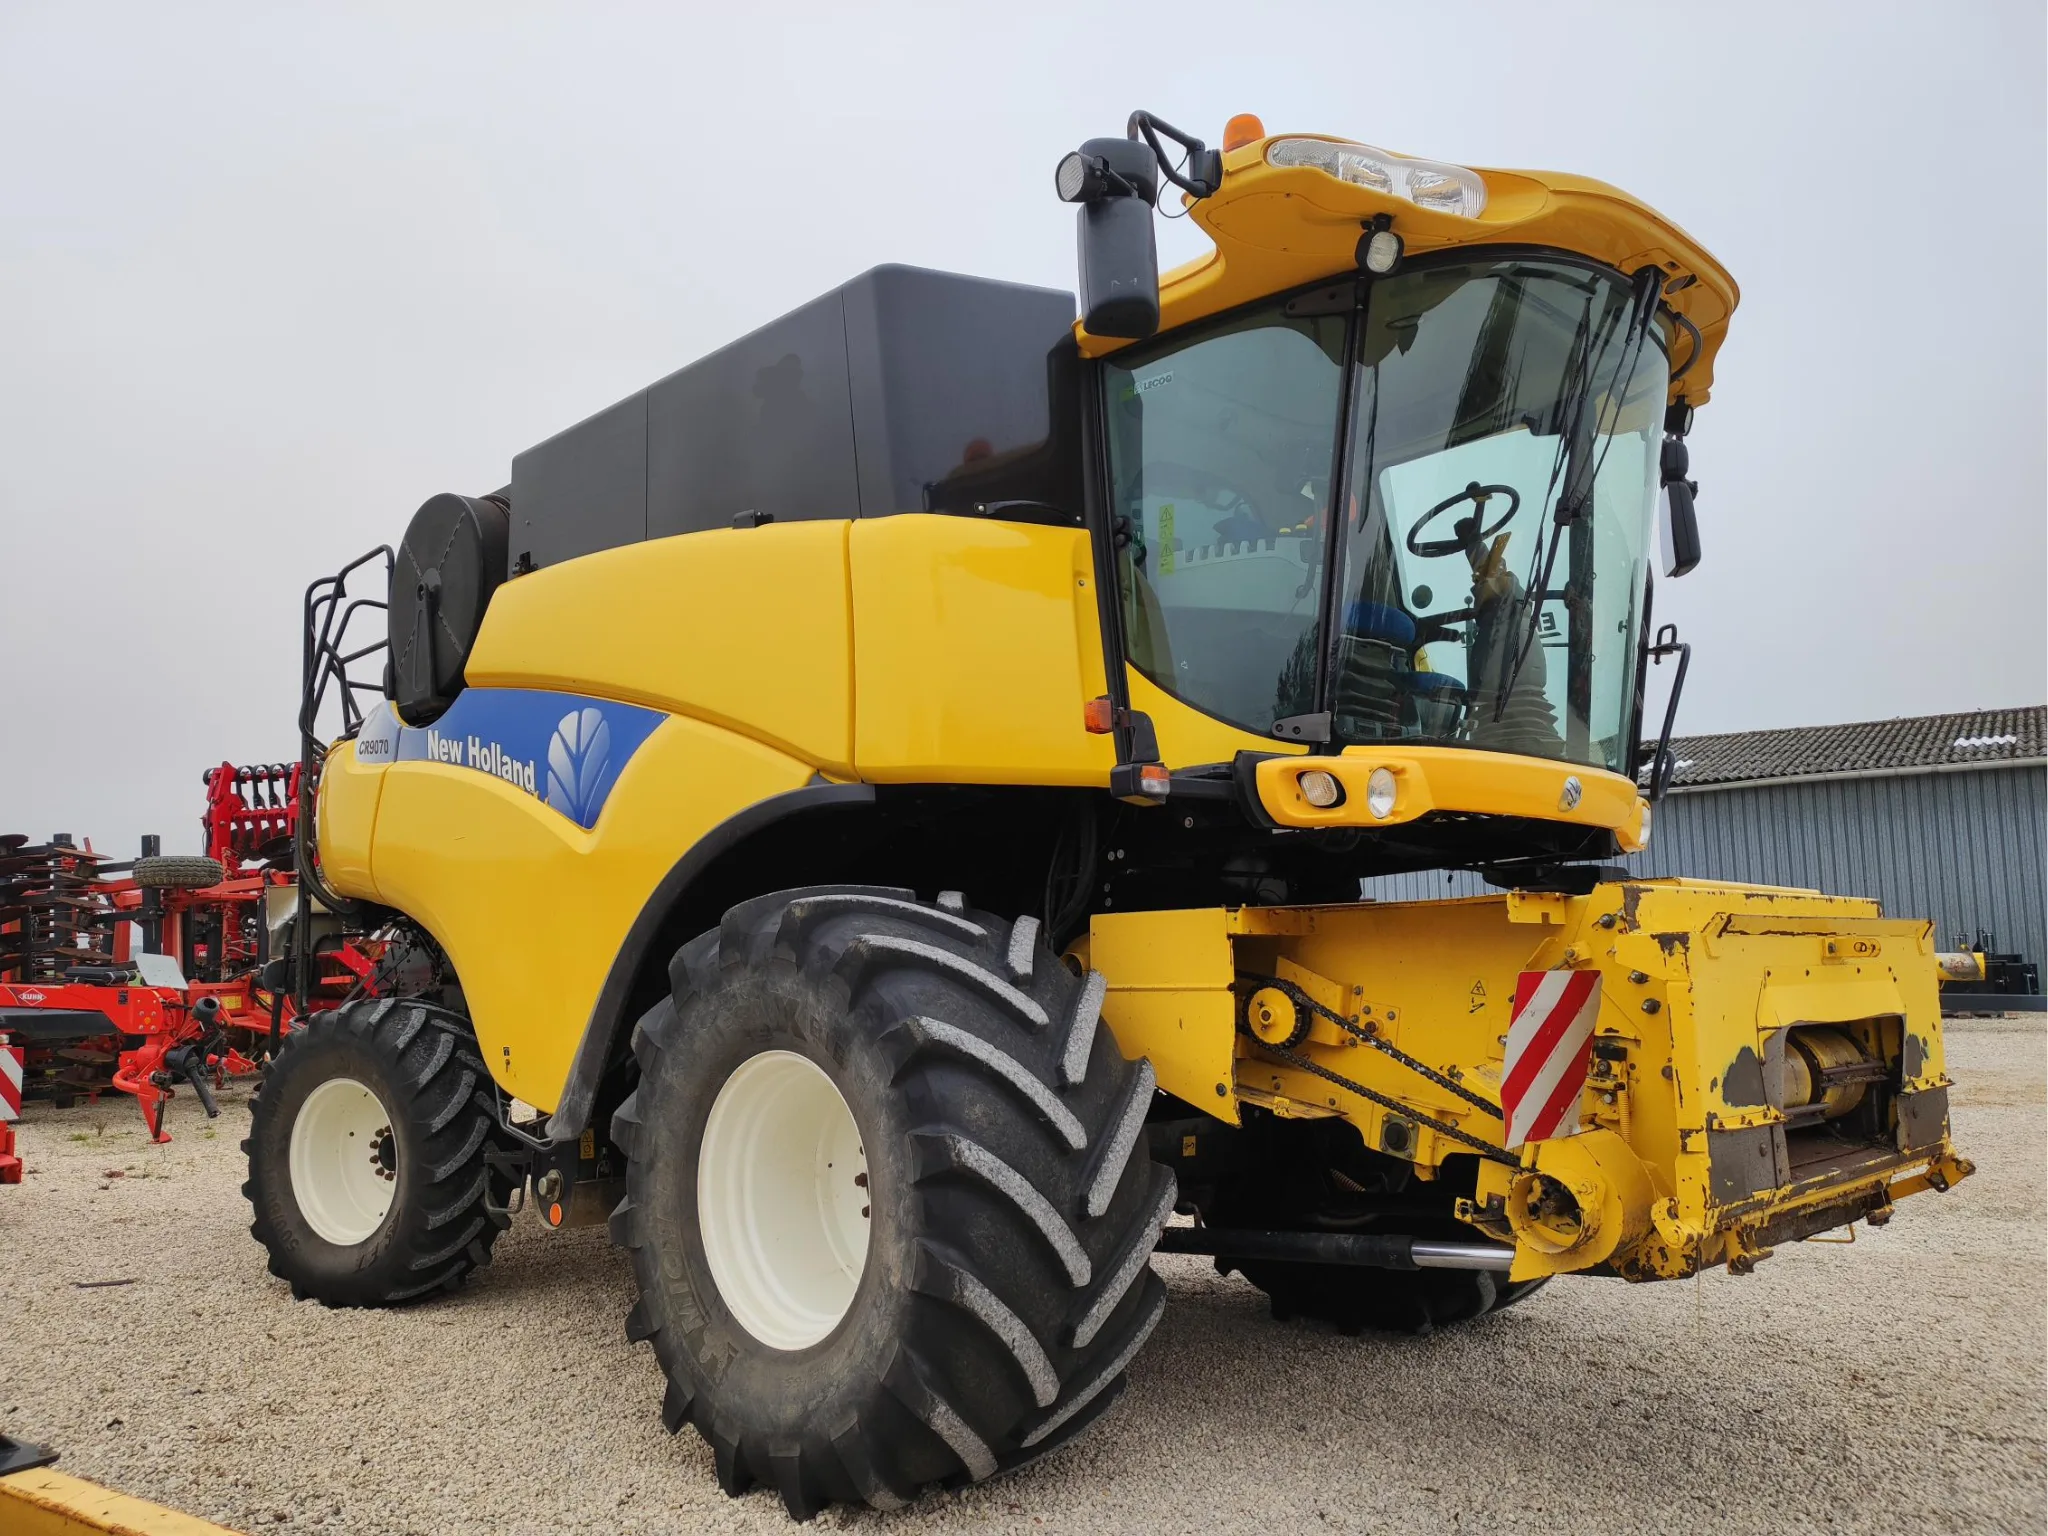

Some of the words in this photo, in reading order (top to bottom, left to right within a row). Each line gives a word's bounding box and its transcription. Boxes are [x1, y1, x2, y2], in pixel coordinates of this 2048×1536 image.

[1143, 375, 1172, 390] LECOQ
[358, 739, 389, 755] CR9070
[427, 729, 463, 763] New
[468, 735, 536, 791] Holland
